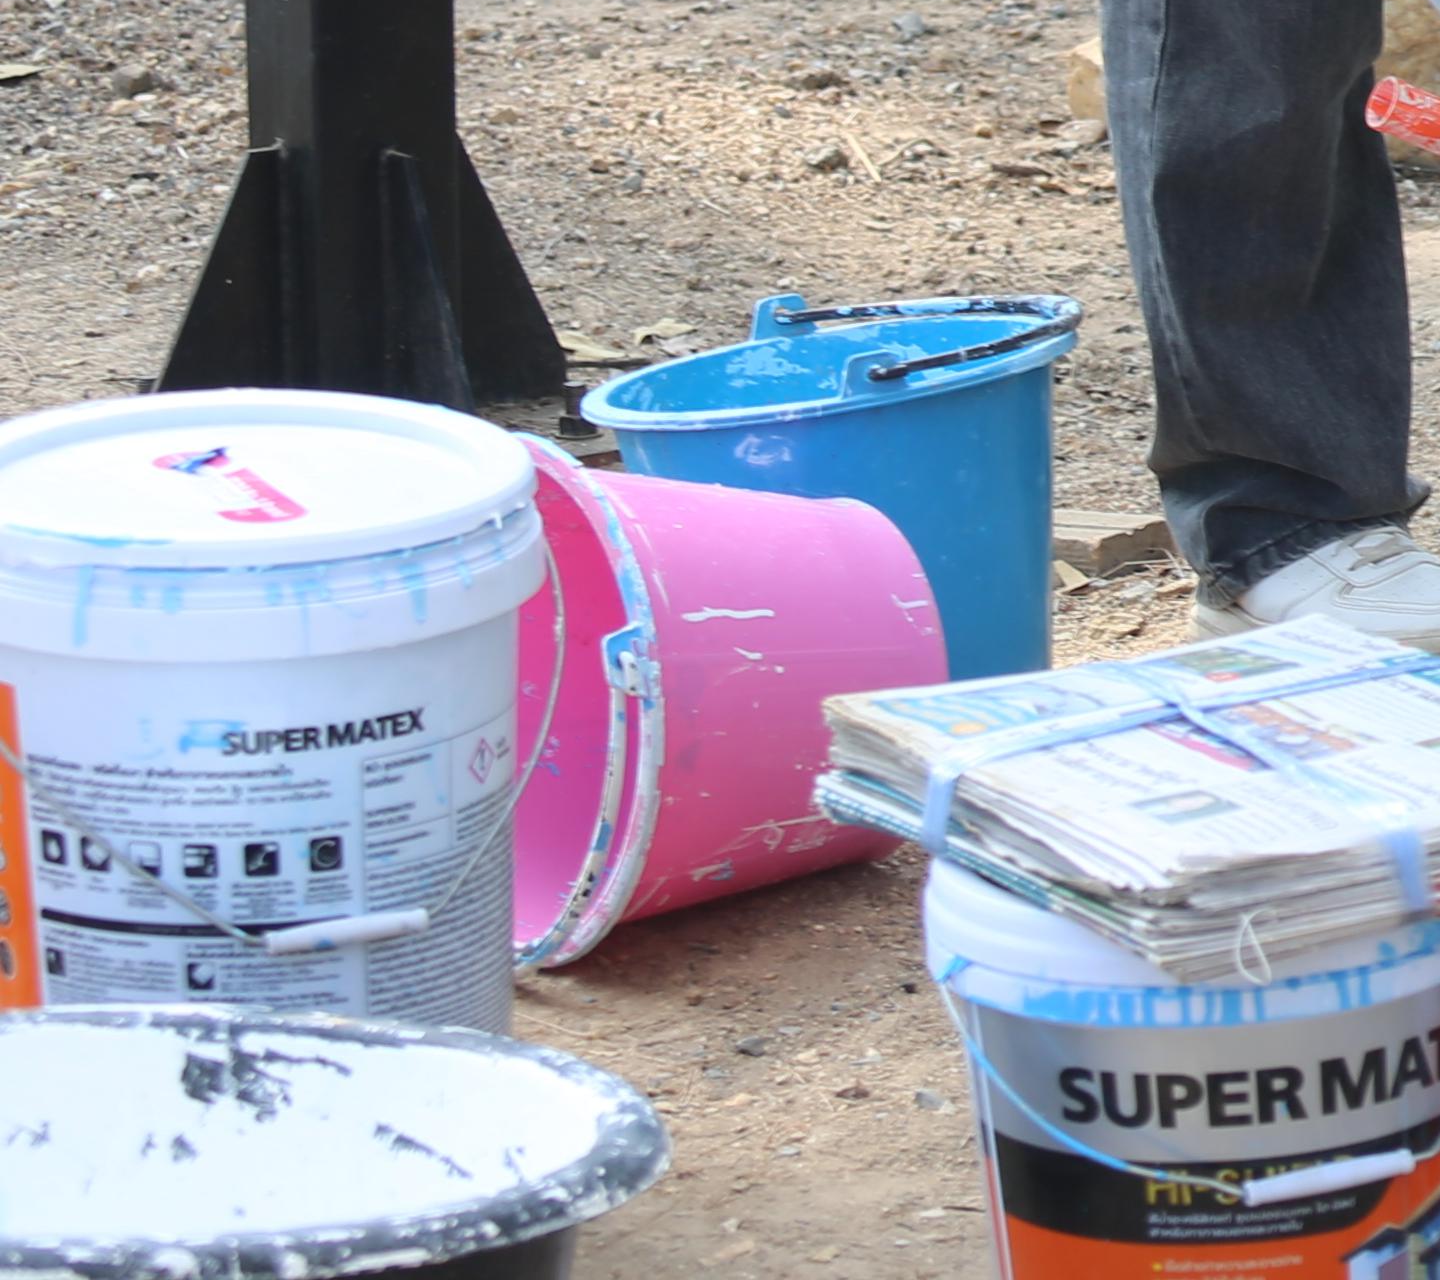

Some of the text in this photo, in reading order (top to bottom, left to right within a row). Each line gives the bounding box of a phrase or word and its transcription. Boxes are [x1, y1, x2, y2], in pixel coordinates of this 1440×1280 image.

[221, 707, 425, 756] SUPER MATEX
[1058, 1065, 1309, 1129] SUPER
